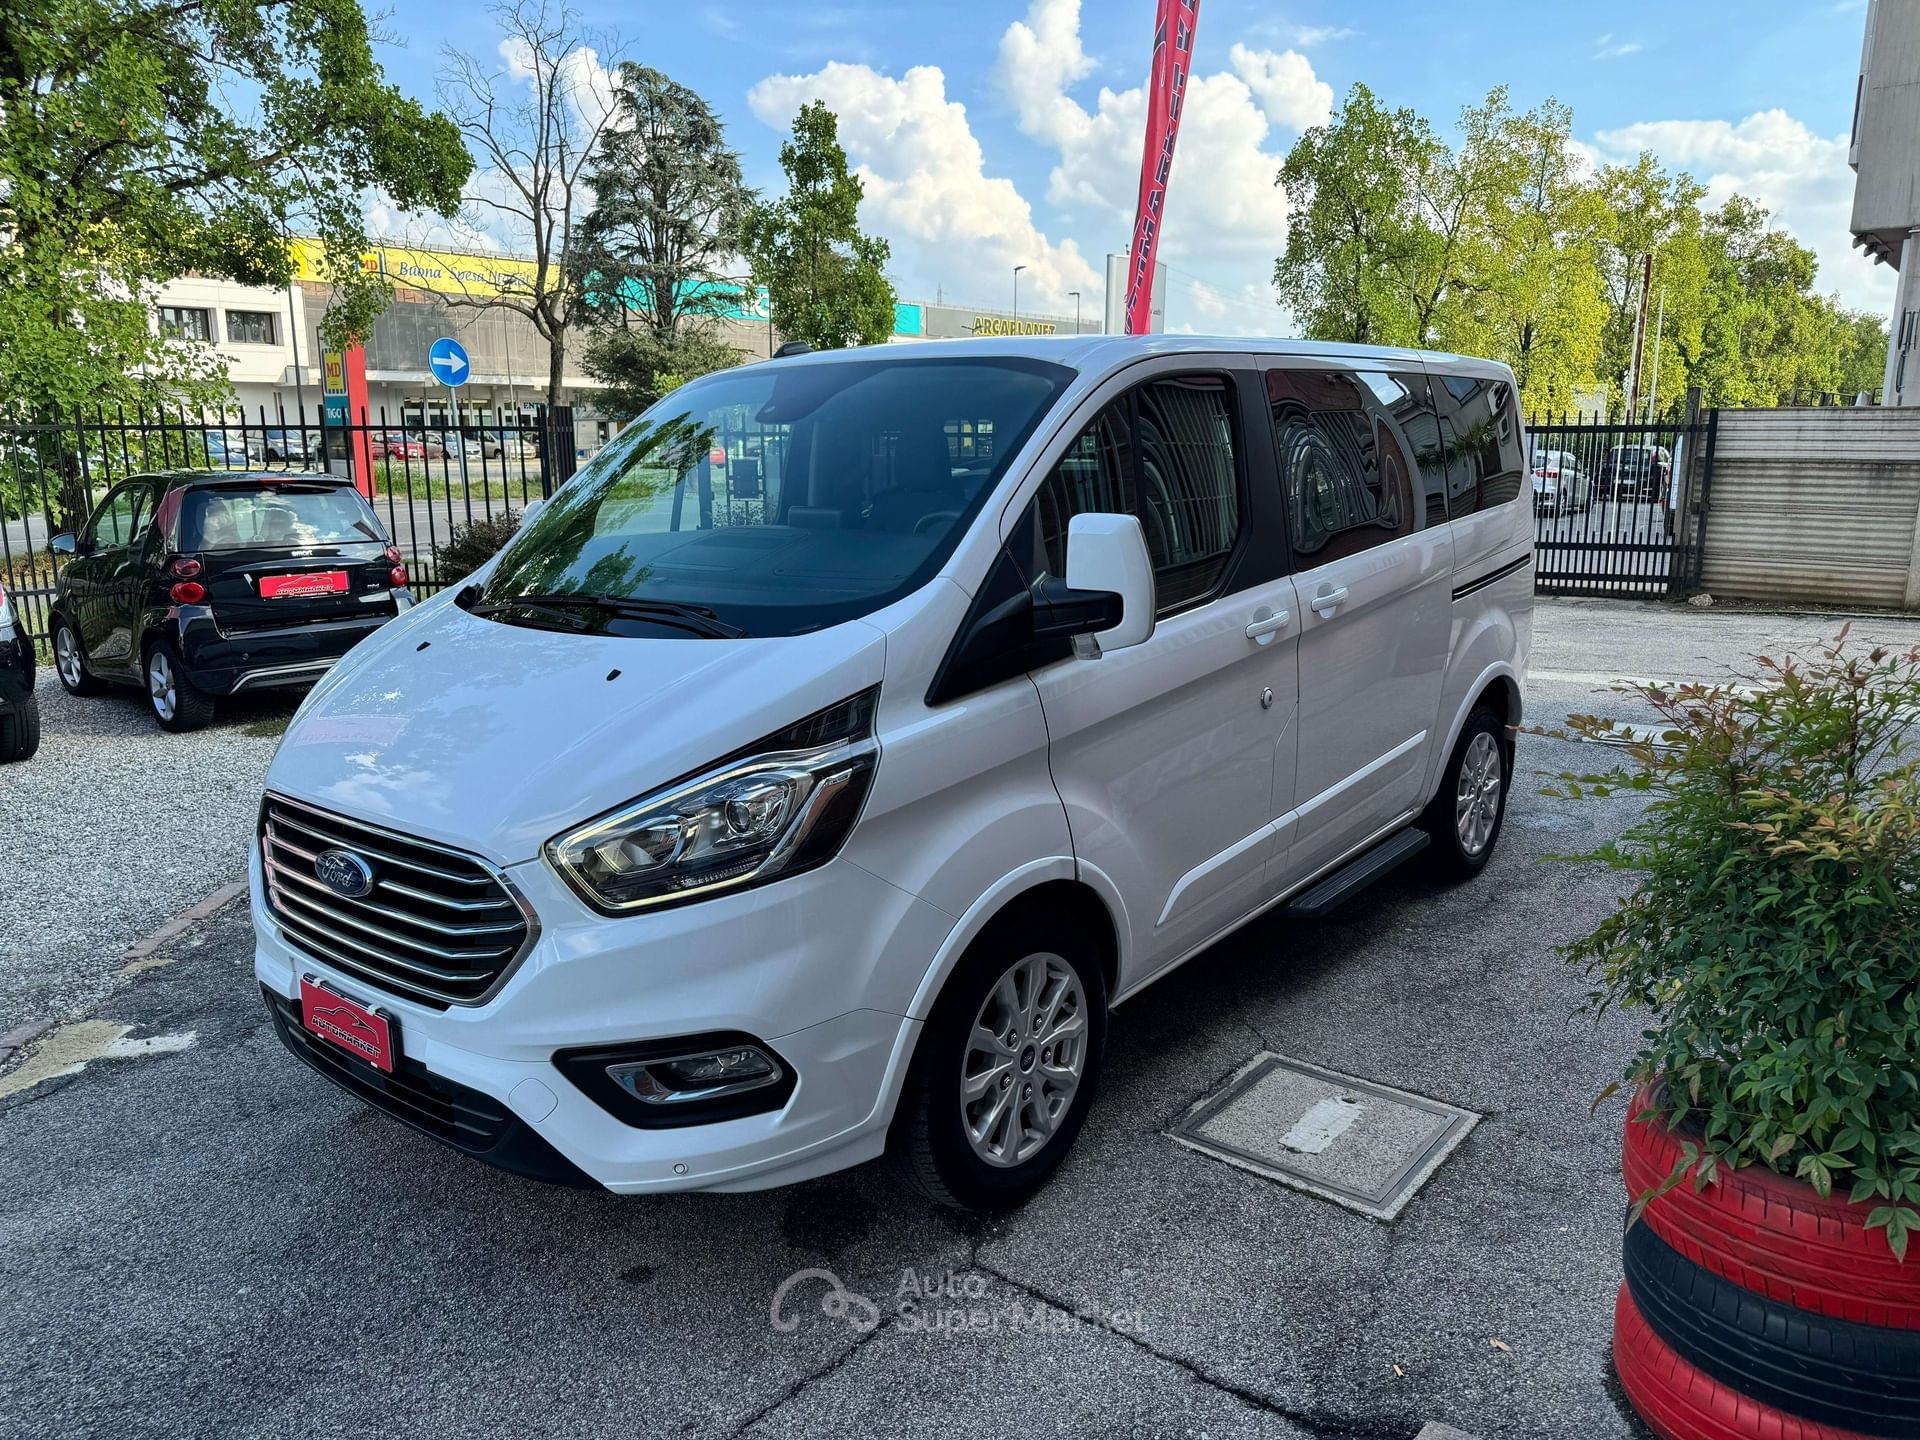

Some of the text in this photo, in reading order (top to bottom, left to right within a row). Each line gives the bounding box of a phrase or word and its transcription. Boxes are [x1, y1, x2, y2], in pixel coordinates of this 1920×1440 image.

[1124, 62, 1187, 335] UTOMARKET
[399, 261, 442, 279] Buona
[449, 265, 485, 283] Spesa
[973, 315, 1057, 336] ARCAPLANET
[326, 362, 342, 378] MD
[291, 549, 313, 557] smart
[275, 583, 334, 596] AUTOMARKET
[321, 855, 354, 888] Ford
[311, 1014, 382, 1059] AUTOMARKET
